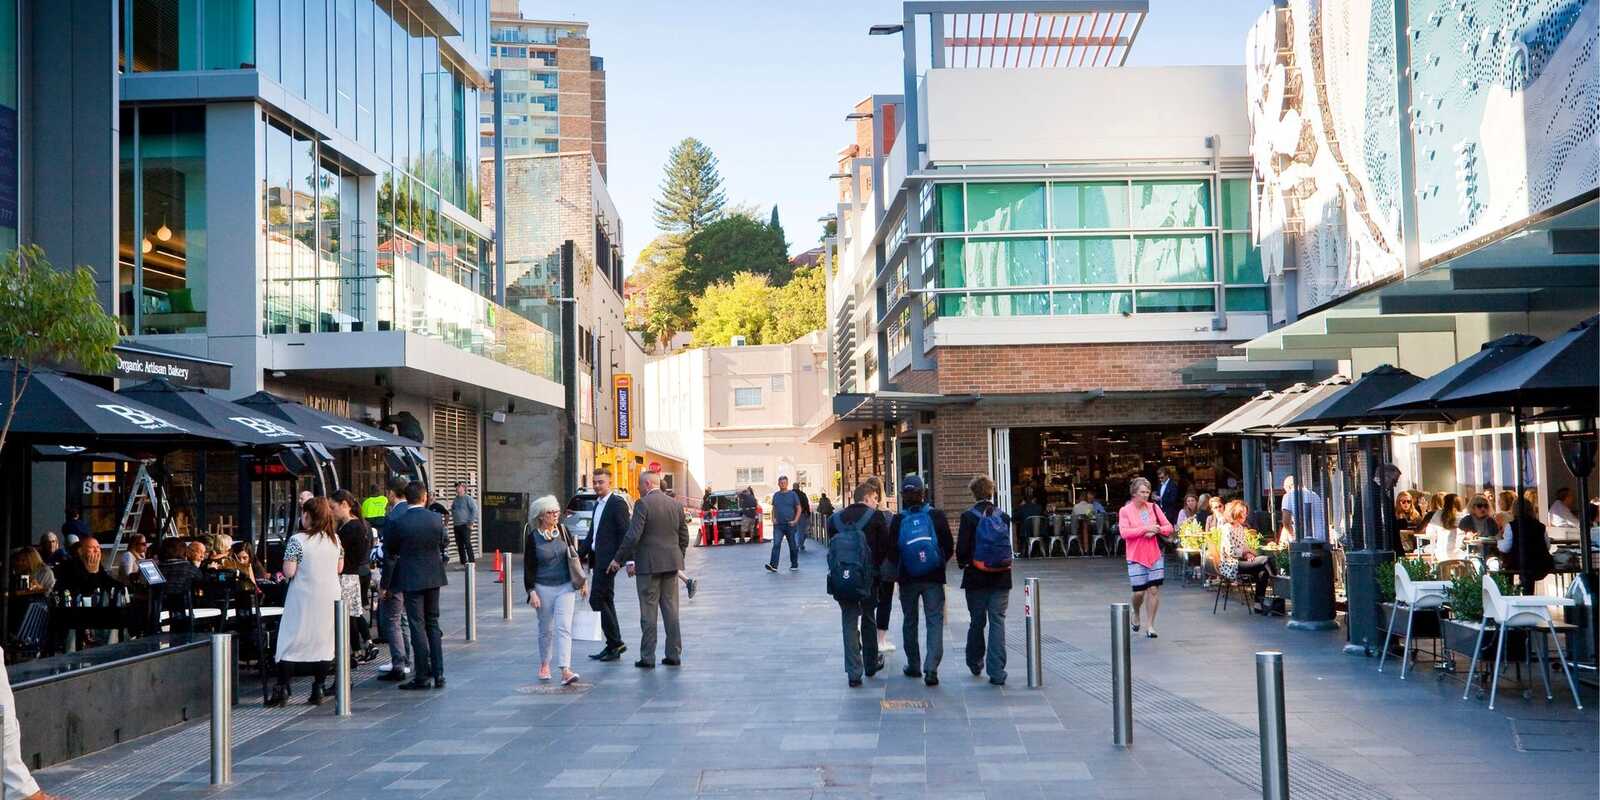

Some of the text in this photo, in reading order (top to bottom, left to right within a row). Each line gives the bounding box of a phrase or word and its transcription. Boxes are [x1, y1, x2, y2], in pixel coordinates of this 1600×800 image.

[117, 358, 189, 380] Organic Artisan Bakery
